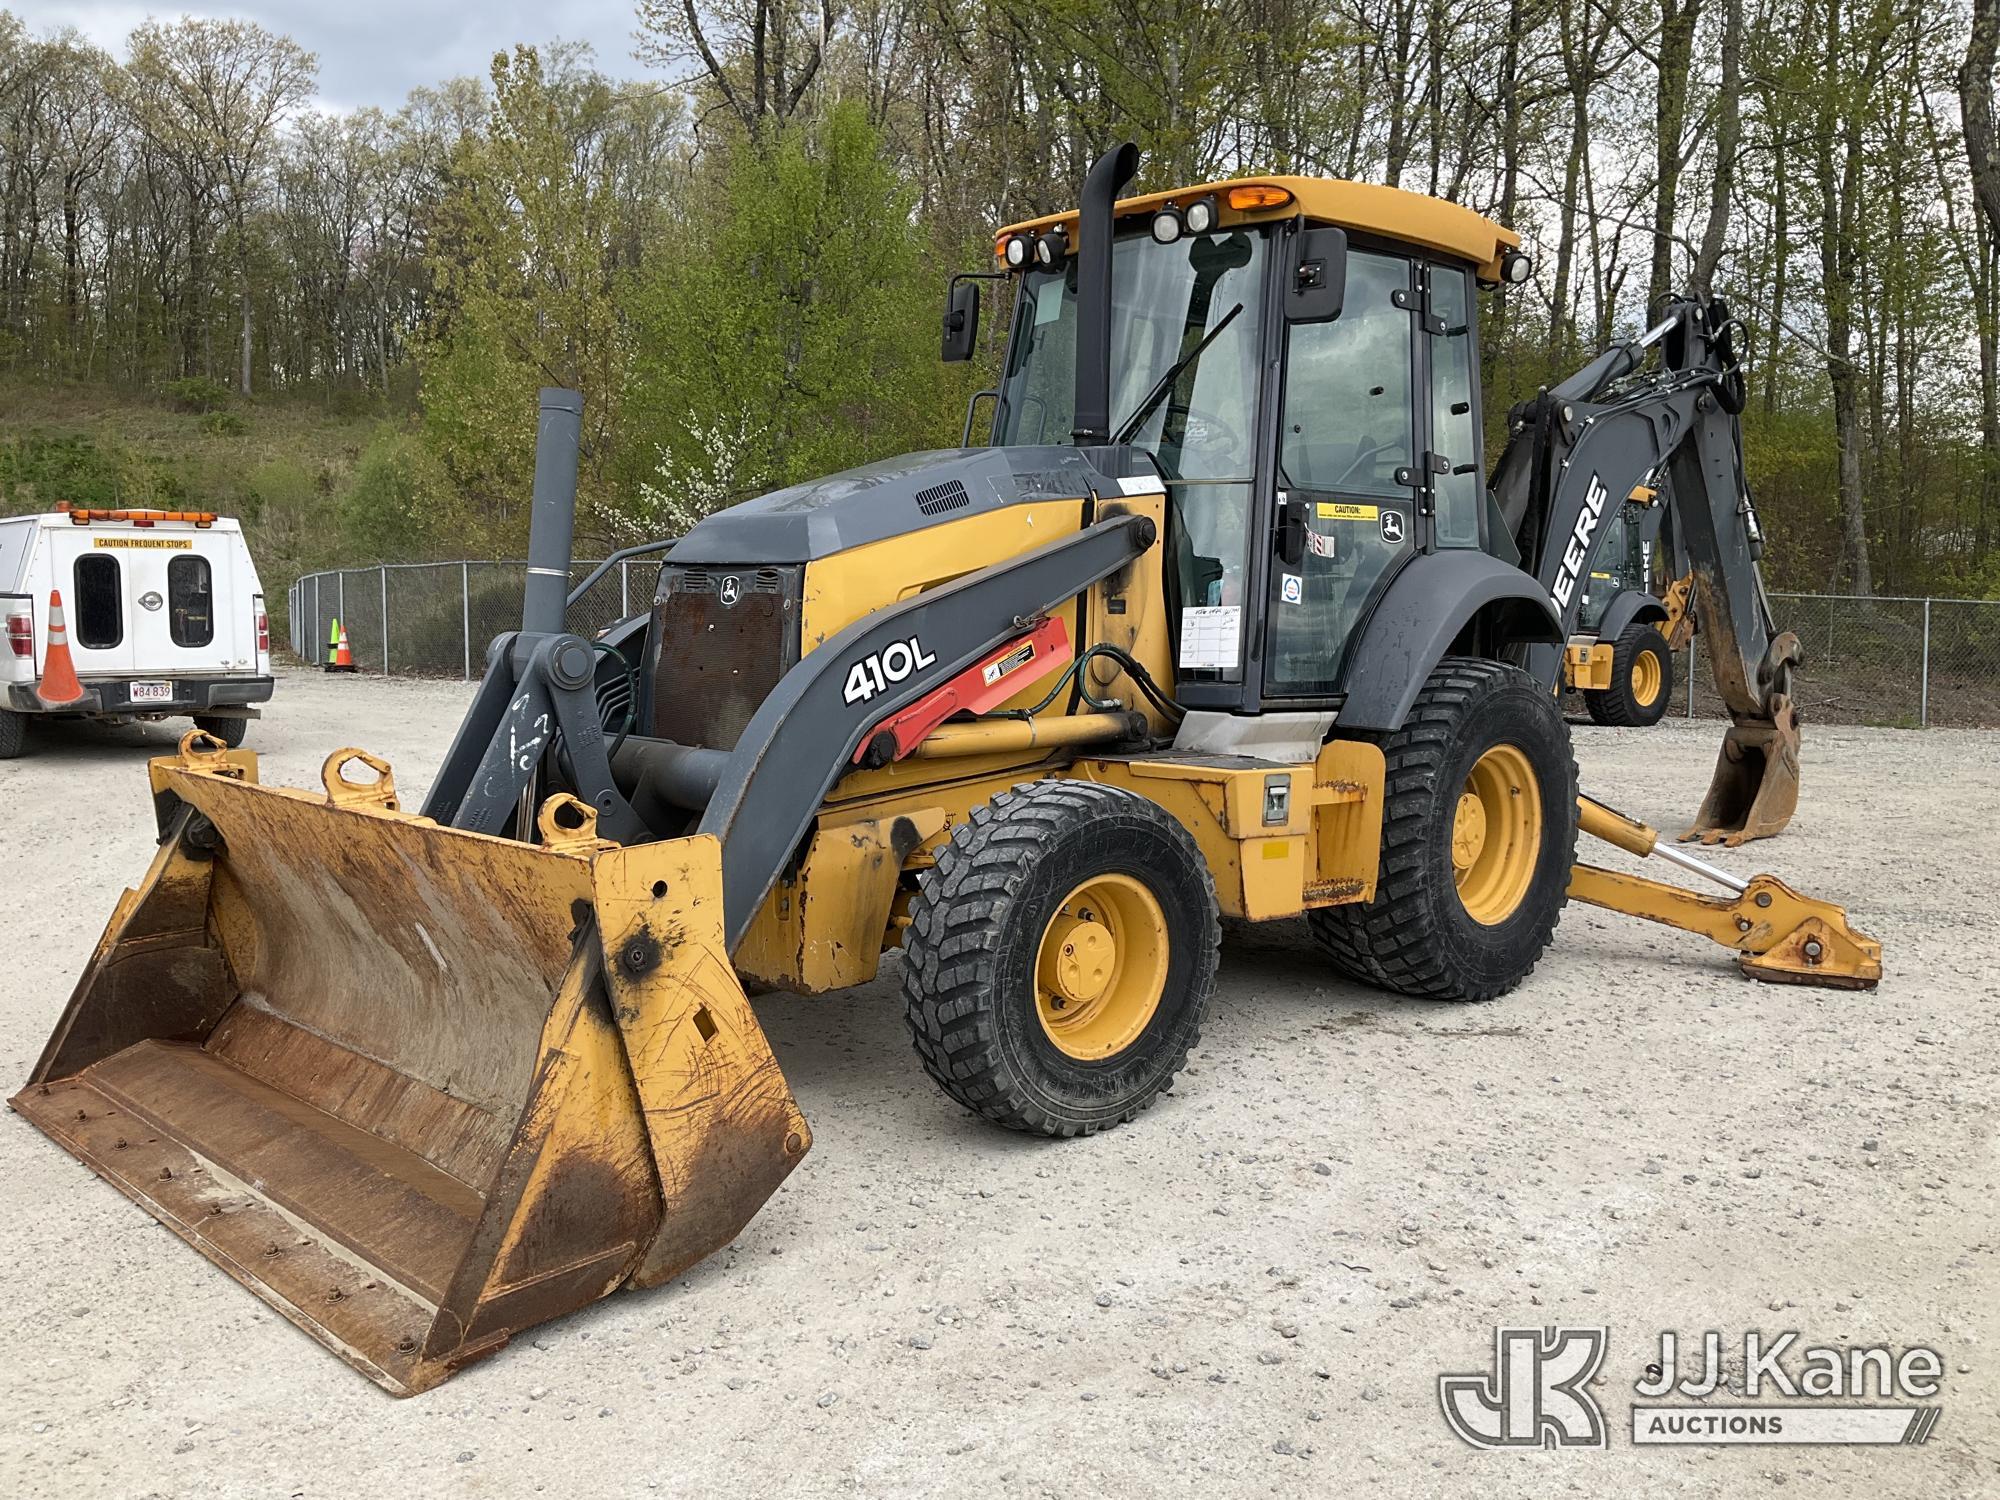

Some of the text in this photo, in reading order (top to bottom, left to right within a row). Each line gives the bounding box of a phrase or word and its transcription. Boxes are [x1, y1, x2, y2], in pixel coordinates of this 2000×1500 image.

[1334, 505, 1361, 514] CAUTION:
[99, 539, 129, 548] CAUTION
[131, 540, 165, 548] FREQUENT
[843, 637, 936, 704] 410L
[152, 687, 170, 697] 839
